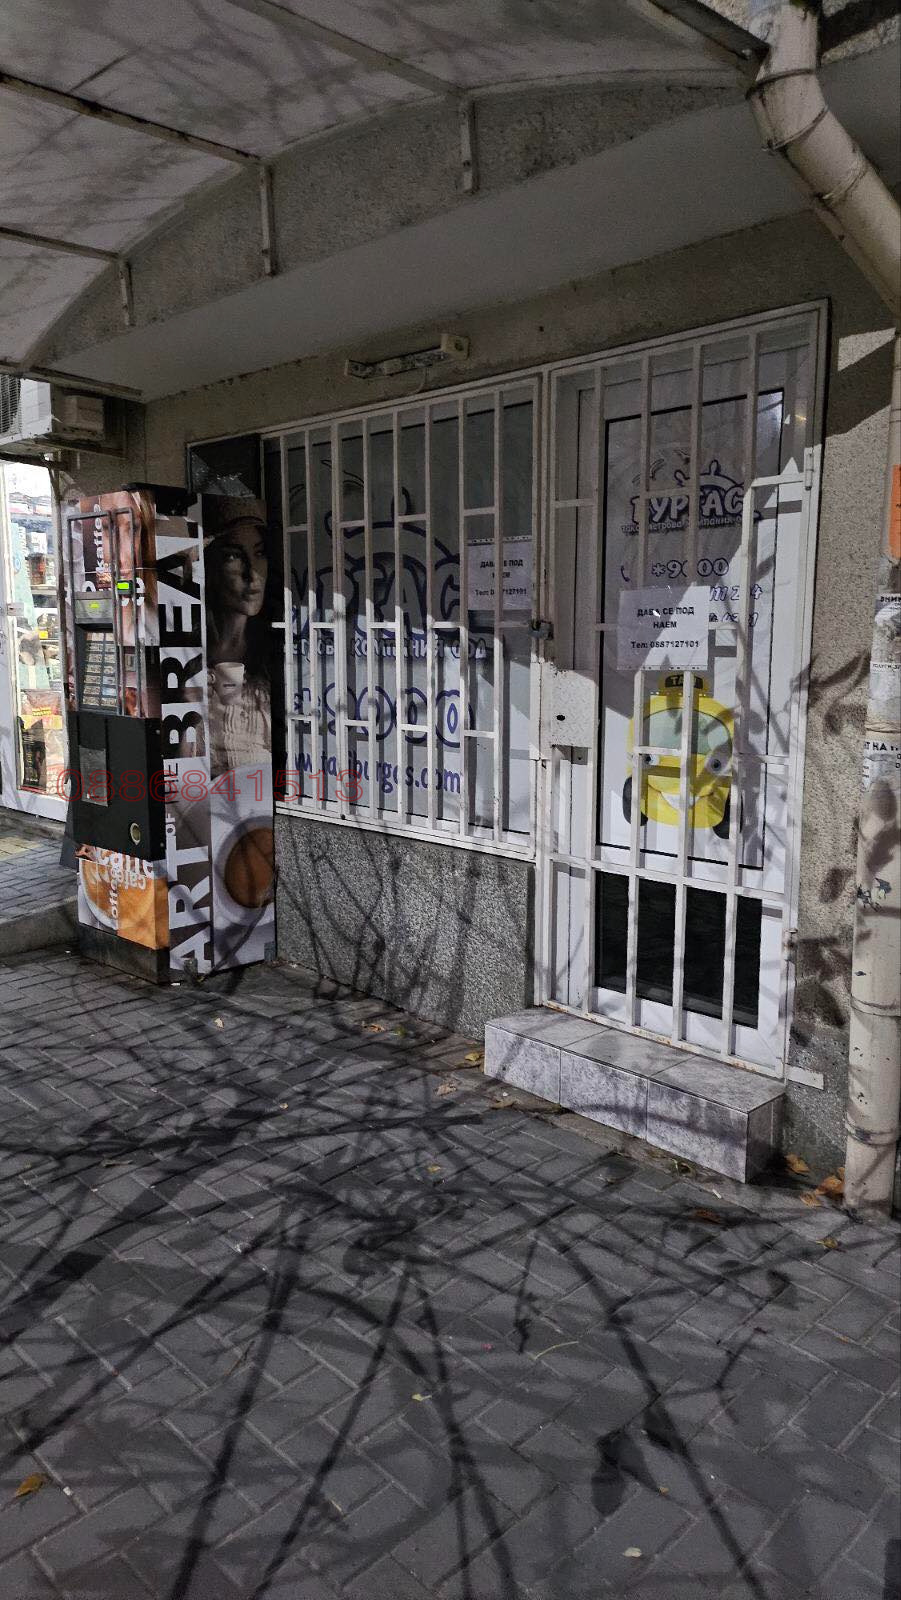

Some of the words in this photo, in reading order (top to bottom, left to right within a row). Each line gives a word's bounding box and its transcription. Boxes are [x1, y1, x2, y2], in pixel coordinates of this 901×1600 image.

[662, 607, 674, 616] СЕ
[675, 606, 695, 616] ПОД
[653, 621, 677, 629] НАЕМ
[631, 641, 648, 649] Тел:
[164, 812, 177, 837] OF
[166, 834, 212, 972] ART
